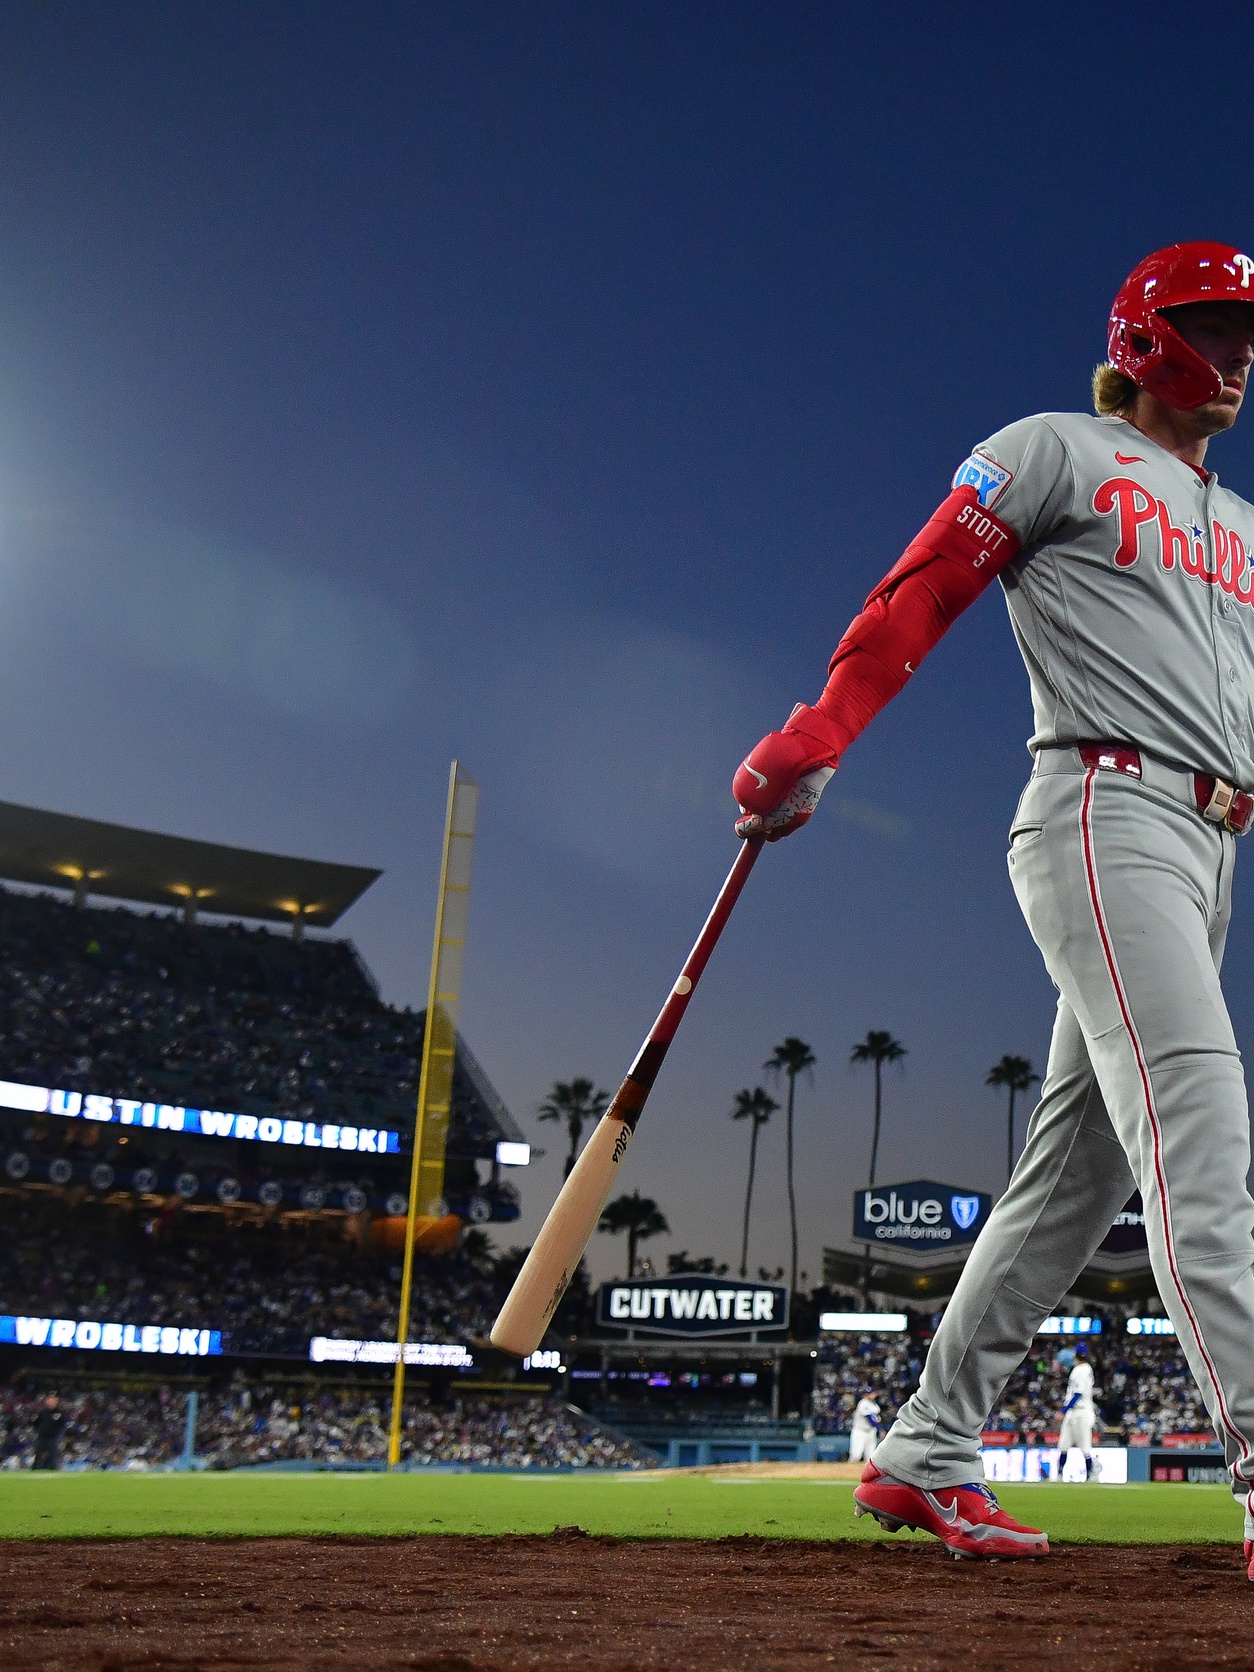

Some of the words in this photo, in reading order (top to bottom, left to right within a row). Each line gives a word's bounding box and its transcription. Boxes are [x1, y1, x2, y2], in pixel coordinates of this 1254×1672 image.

[956, 505, 1009, 551] STOTT
[972, 549, 991, 569] 5
[200, 1110, 389, 1154] WROBLESKI
[612, 1124, 632, 1164] ictus
[864, 1191, 943, 1225] blue
[875, 1224, 952, 1240] california
[610, 1287, 774, 1321] CUTWATER
[15, 1316, 210, 1356] WROBLESKI
[1187, 1467, 1231, 1484] UNIQ
